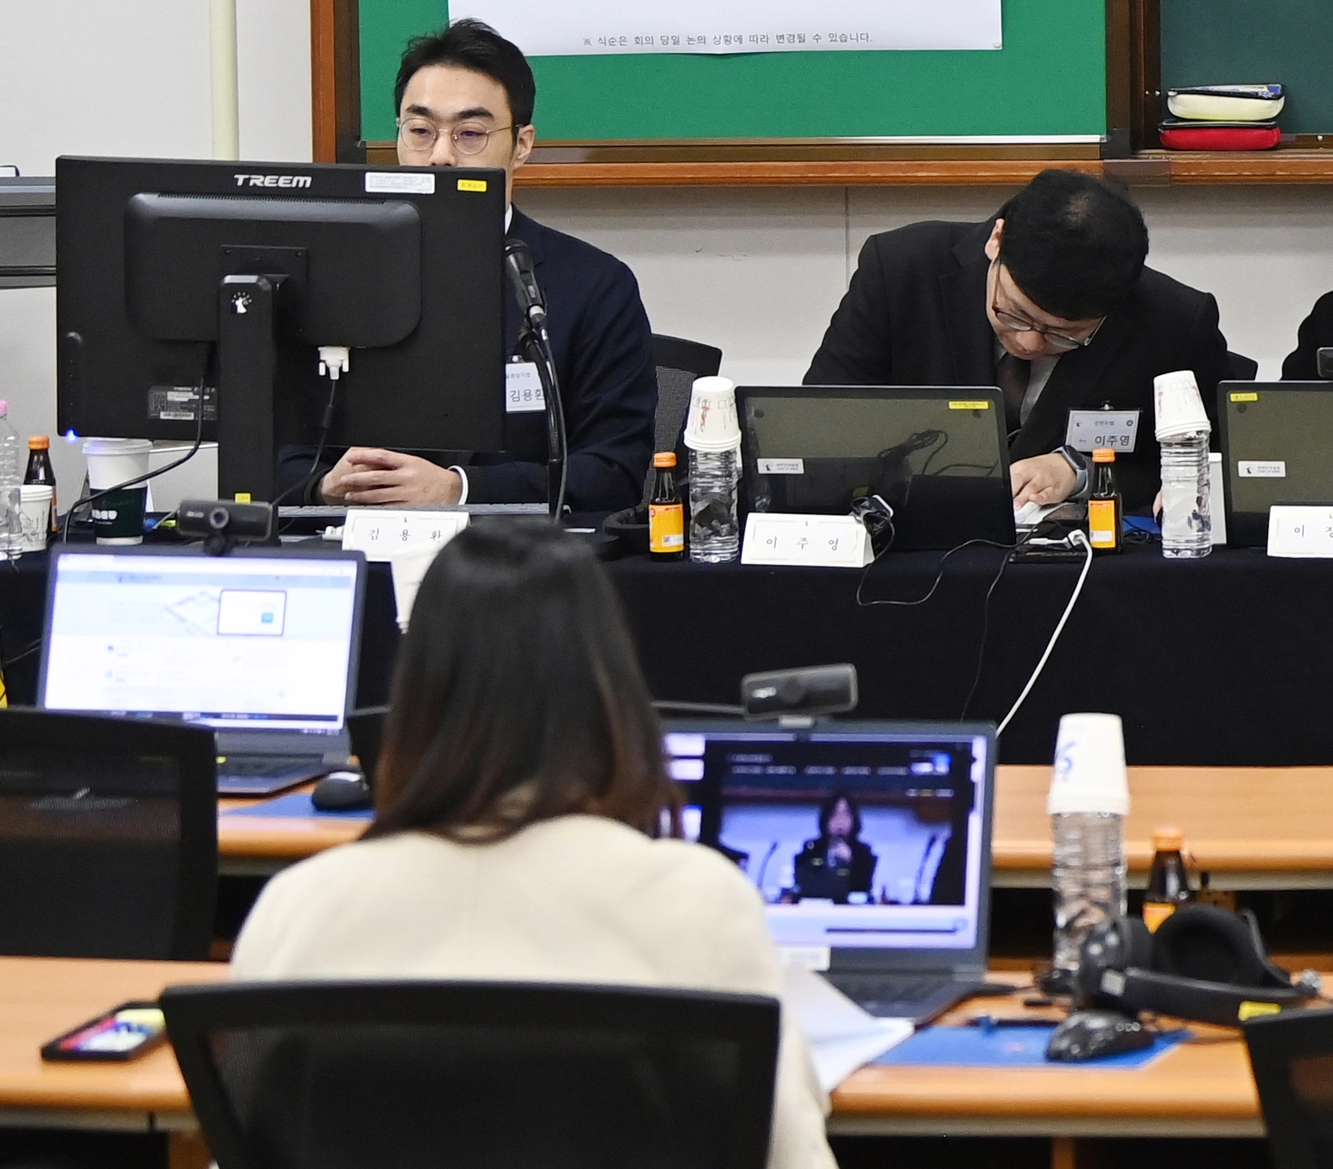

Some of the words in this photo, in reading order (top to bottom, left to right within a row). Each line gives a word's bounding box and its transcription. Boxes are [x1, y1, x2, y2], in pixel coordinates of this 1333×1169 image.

[597, 35, 628, 47] 식순은
[633, 35, 655, 46] 회의
[659, 34, 681, 47] 당일
[685, 35, 707, 46] 논의
[712, 34, 744, 46] 상황에
[748, 33, 770, 45] 따라
[775, 32, 807, 45] 변경될
[811, 32, 823, 44] 수
[827, 32, 873, 44] 있습니다.
[233, 174, 312, 188] TREEM
[1094, 434, 1130, 447] 이주영
